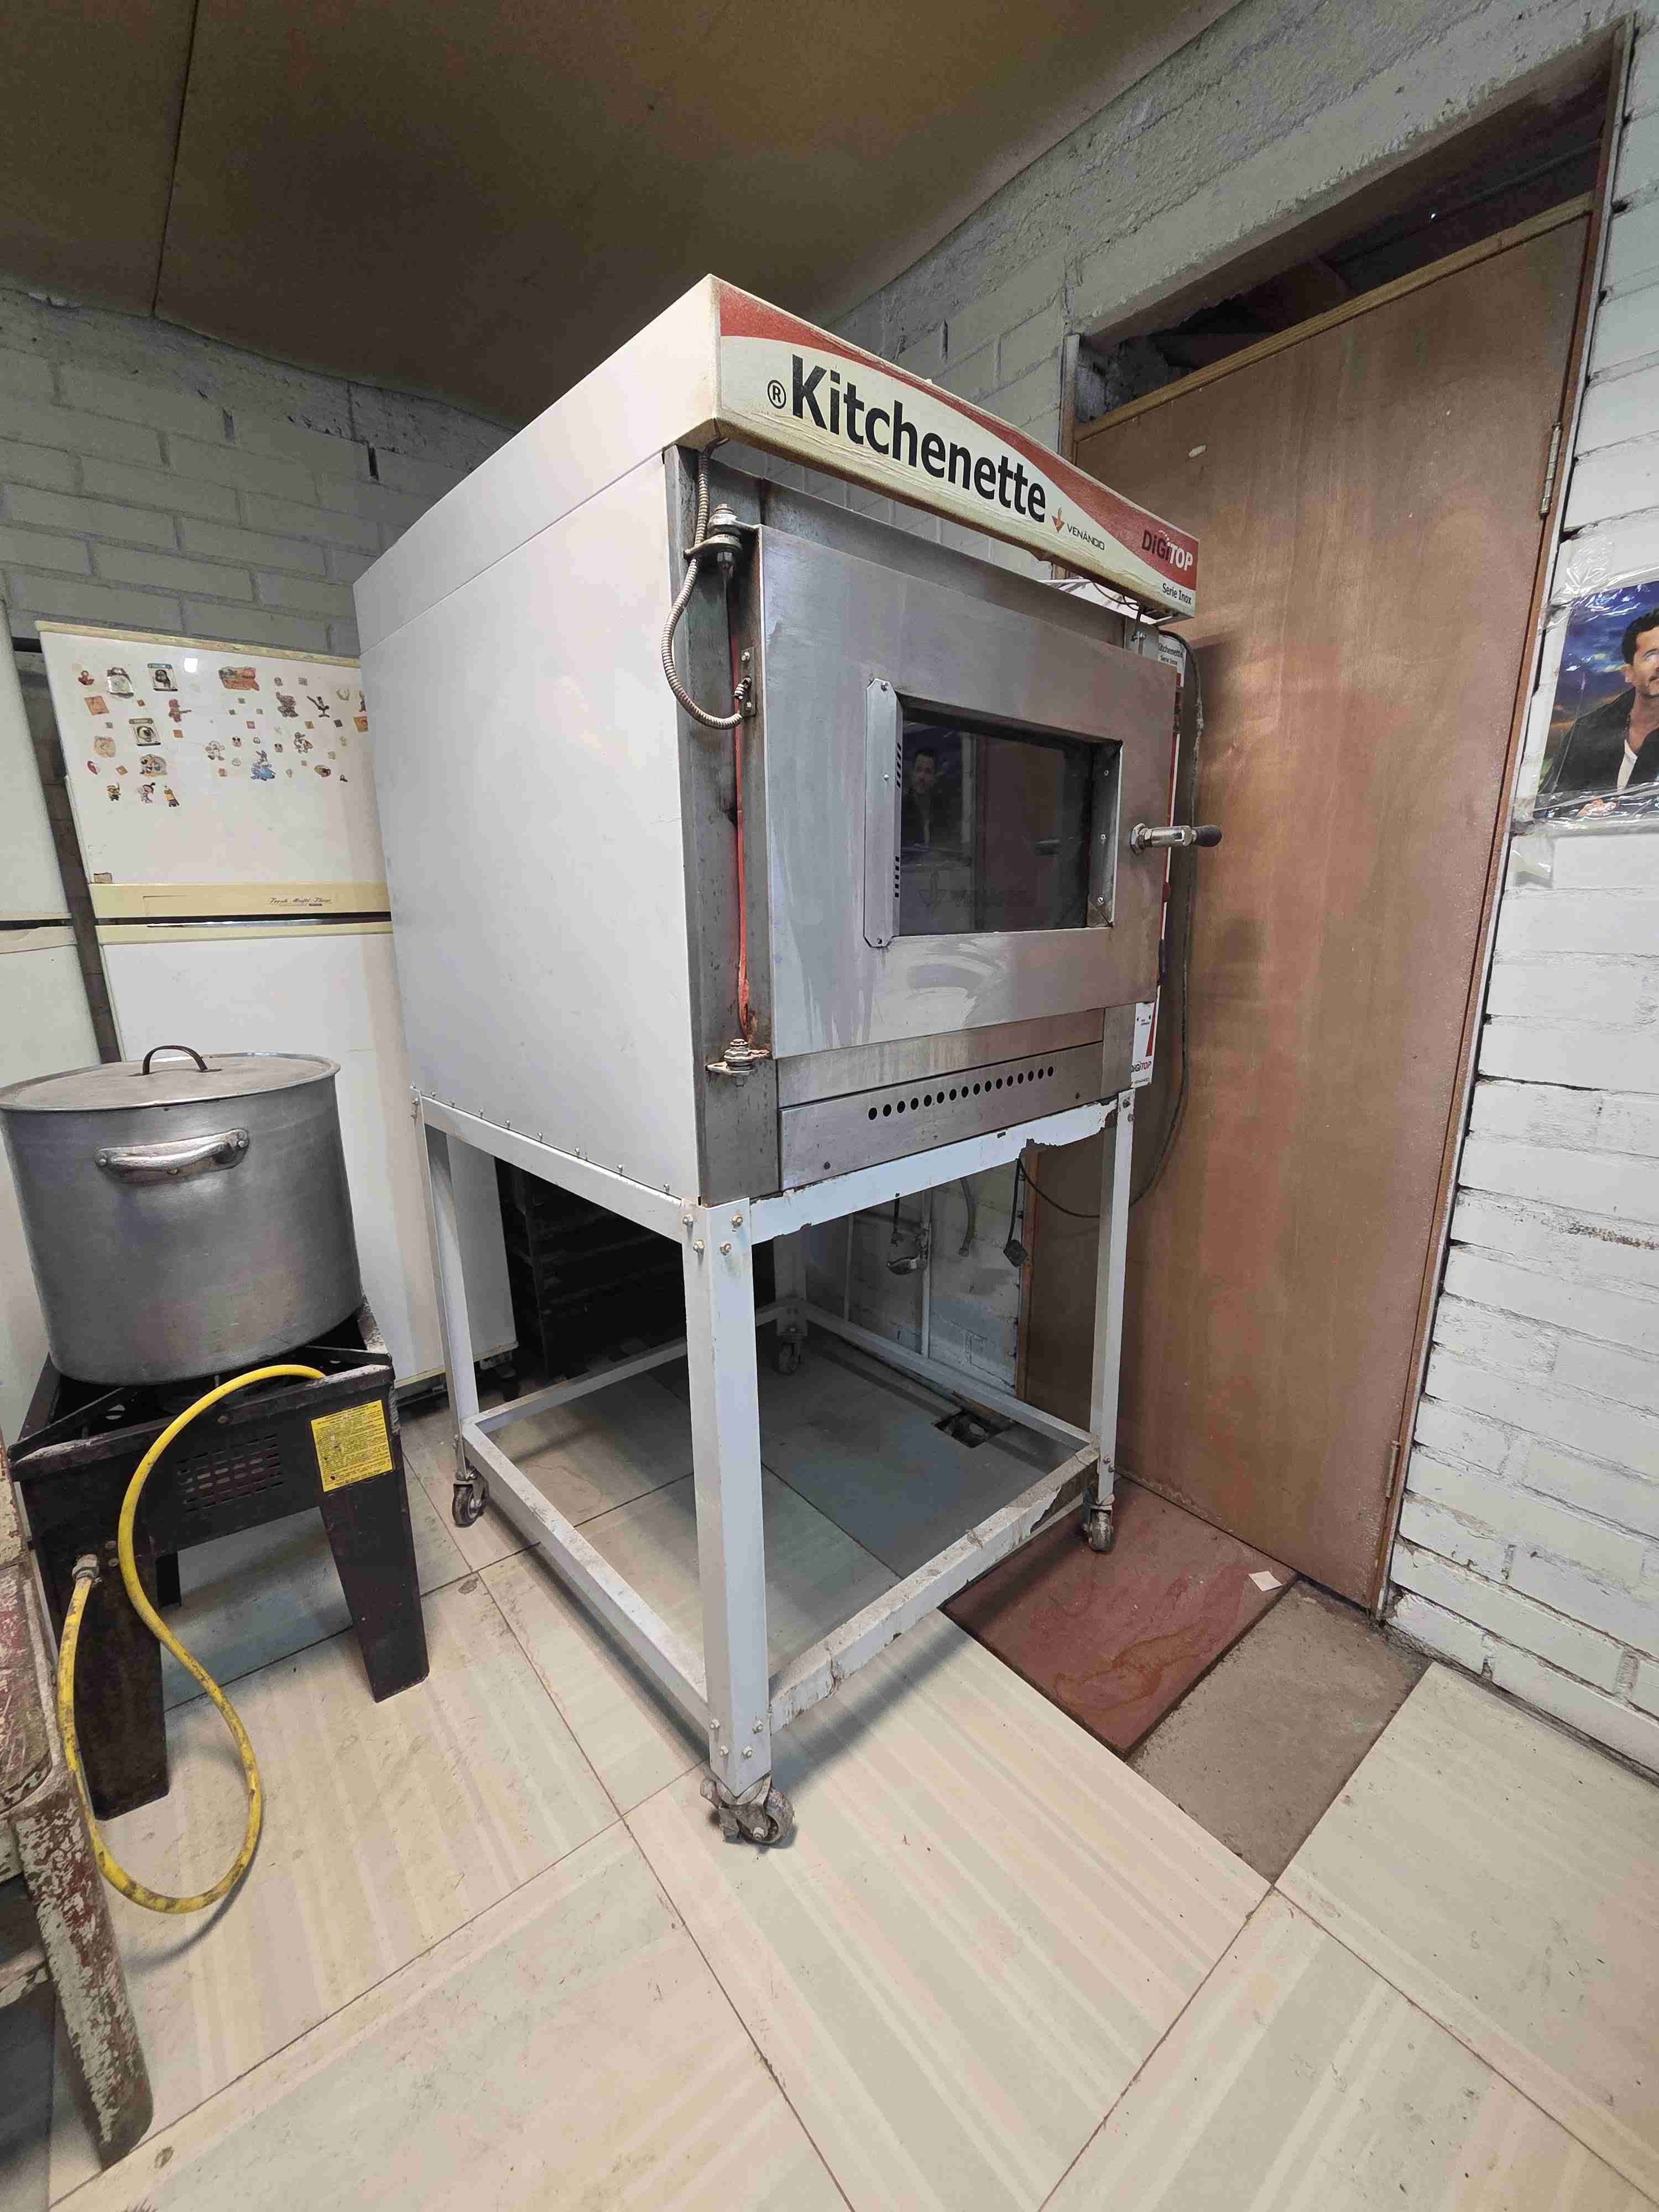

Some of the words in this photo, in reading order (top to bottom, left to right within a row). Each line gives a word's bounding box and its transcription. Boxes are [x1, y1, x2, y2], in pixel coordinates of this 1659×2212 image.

[792, 353, 1046, 523] Kitchenette
[1067, 523, 1105, 550] VENÂNCIO
[1162, 583, 1177, 598] Serie
[1178, 590, 1192, 604] Inox
